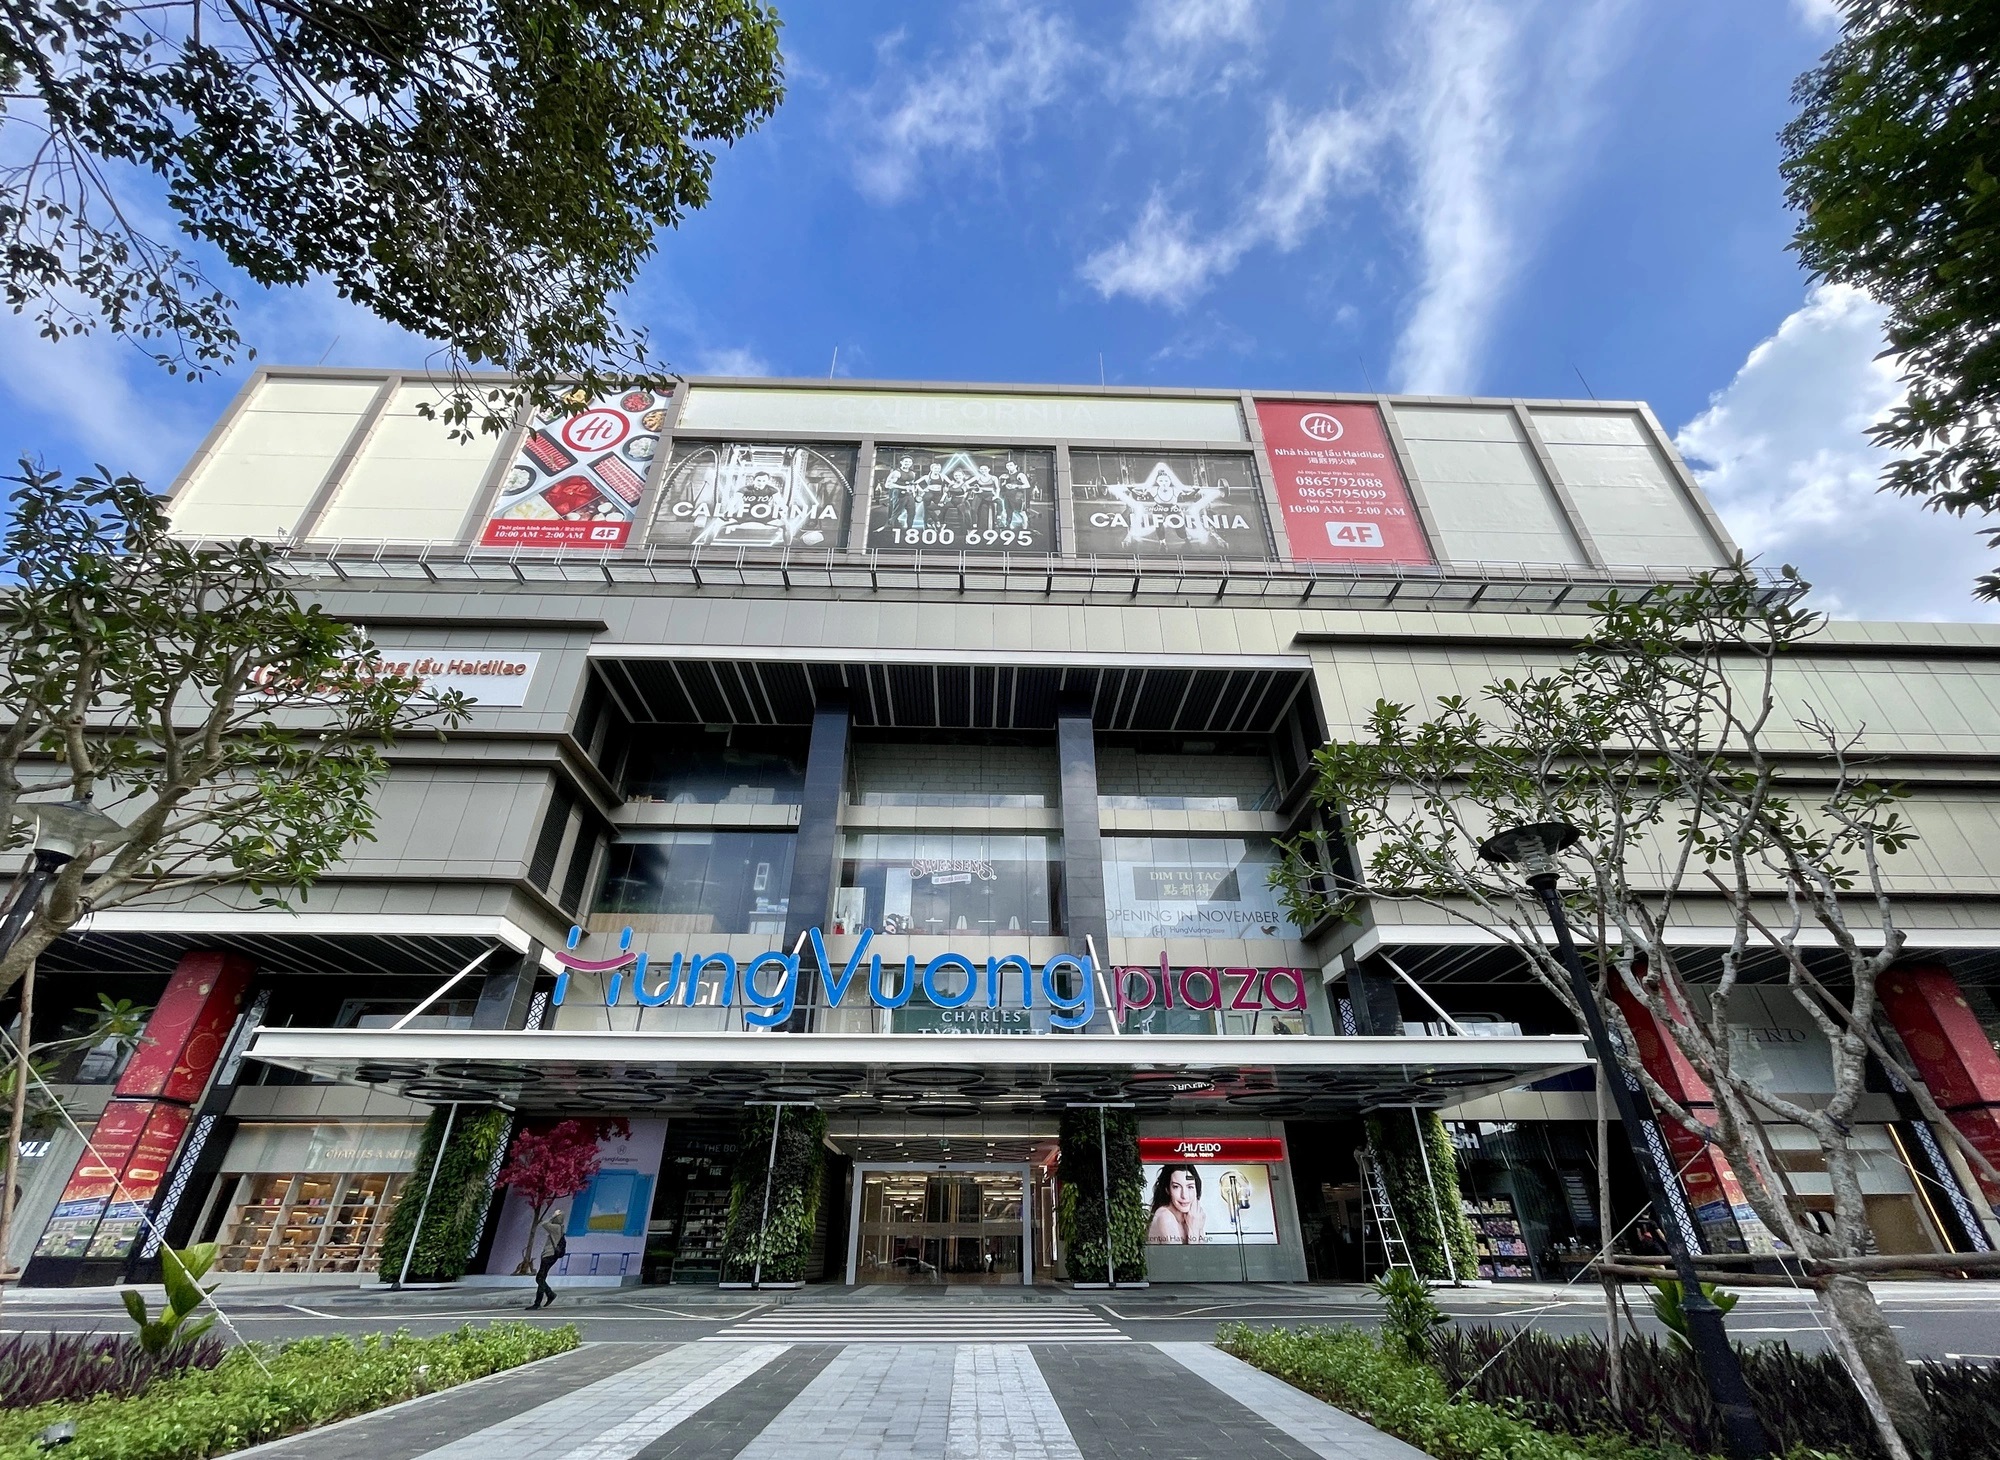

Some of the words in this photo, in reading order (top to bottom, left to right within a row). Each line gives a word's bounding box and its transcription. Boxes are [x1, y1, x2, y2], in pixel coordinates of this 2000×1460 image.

[575, 416, 614, 442] Hi
[1309, 418, 1335, 435] Hi
[1343, 449, 1385, 459] Haidilao
[1295, 476, 1383, 488] 0865792088
[1298, 487, 1387, 500] 0865795099
[672, 501, 838, 520] CALIFORNIA
[1288, 504, 1320, 513] 10:00
[1323, 505, 1345, 514] AM
[1356, 506, 1381, 515] 2:00
[1384, 507, 1406, 517] AM
[1089, 512, 1250, 530] CALIFORNIA
[494, 530, 518, 538] 10:00
[520, 530, 537, 538] AM
[545, 531, 564, 539] 2:00
[566, 531, 584, 539] AM
[595, 528, 616, 538] 4F
[891, 528, 955, 545] 1800
[965, 528, 1033, 547] 6995
[1336, 526, 1374, 543] 4F
[447, 659, 527, 676] Haidilao
[1150, 871, 1173, 881] DIM
[1176, 871, 1193, 881] TU
[1195, 871, 1222, 881] TAC
[1106, 909, 1172, 923] OPENING
[1177, 910, 1192, 922] IN
[1199, 909, 1280, 923] NOVEMBER
[1113, 950, 1308, 1025] plaza
[941, 1011, 1021, 1023] CHARLES
[703, 1143, 721, 1153] THE
[723, 1143, 739, 1153] BO
[1174, 1142, 1222, 1152] SHISEIDO
[1199, 1235, 1213, 1243] Age
